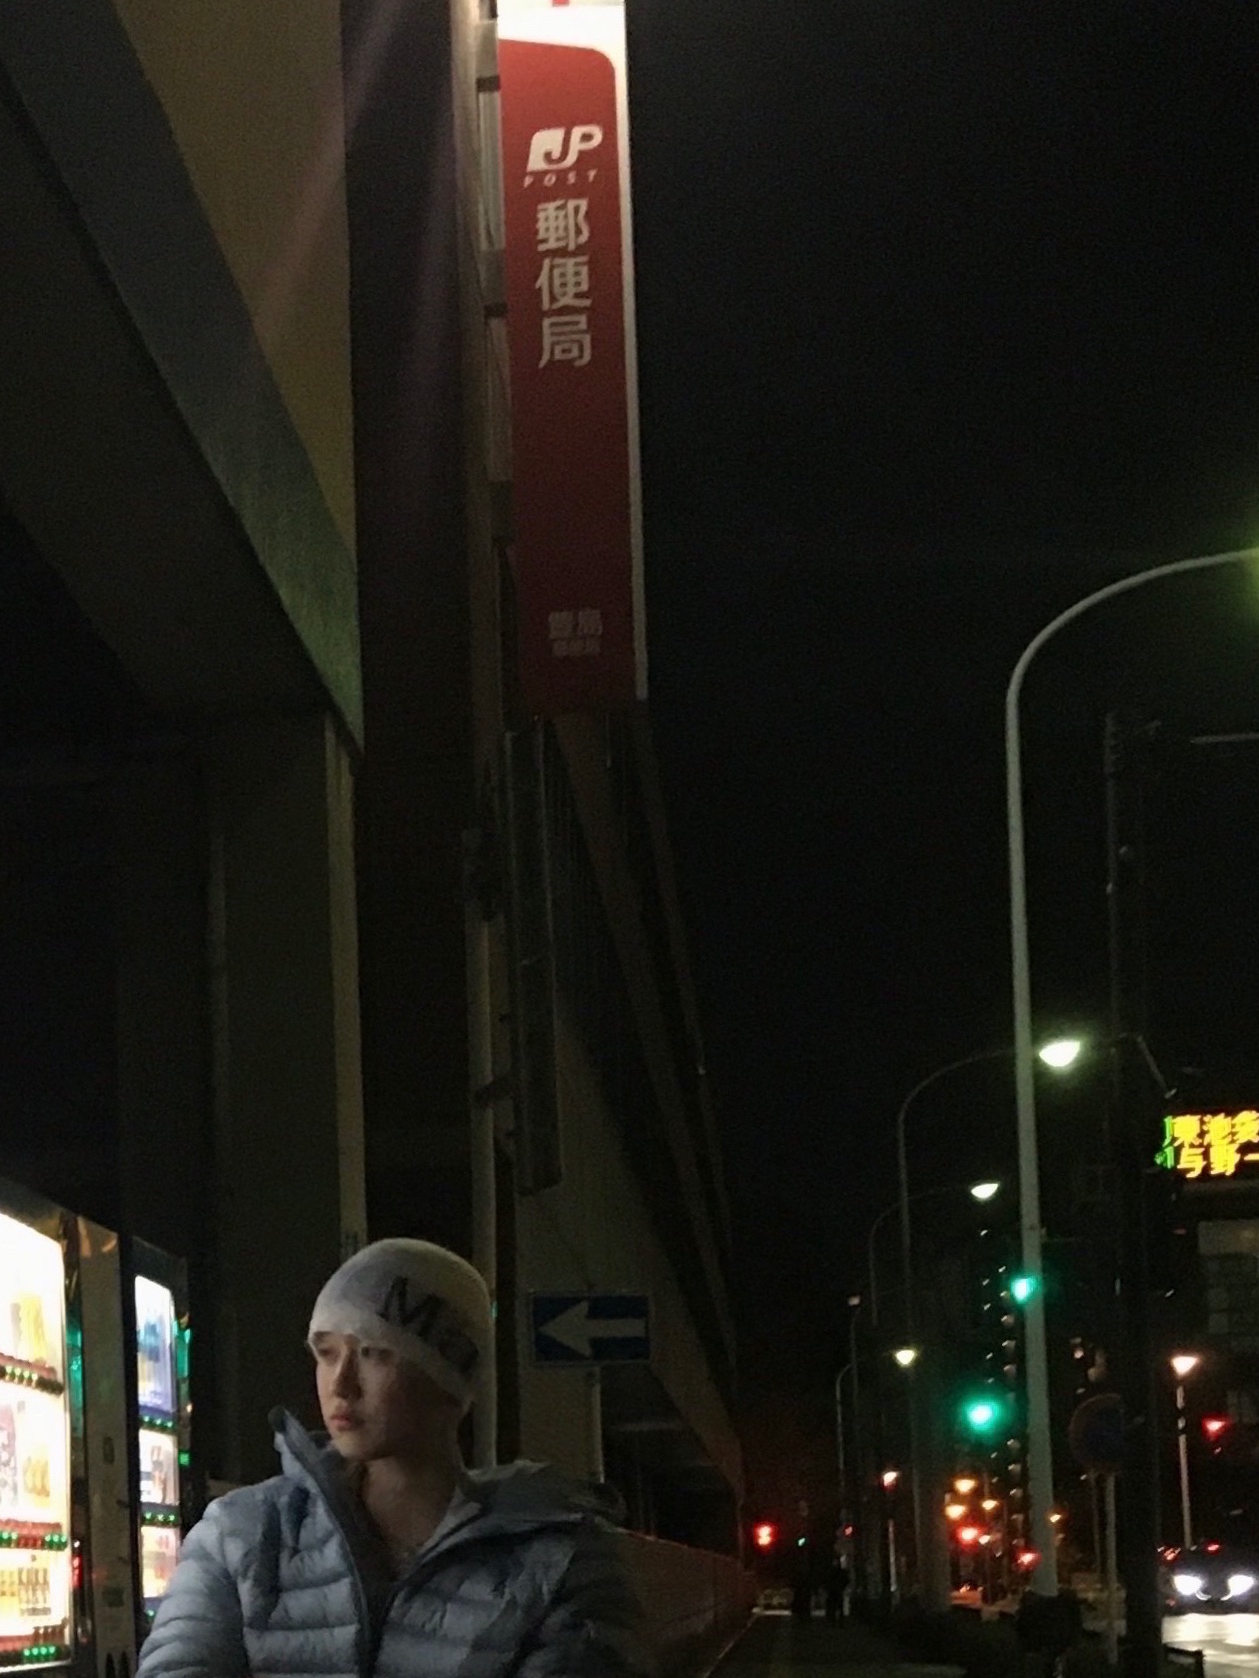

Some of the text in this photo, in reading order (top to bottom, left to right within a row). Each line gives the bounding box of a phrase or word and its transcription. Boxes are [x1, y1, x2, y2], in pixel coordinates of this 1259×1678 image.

[527, 124, 603, 173] JP
[535, 197, 592, 369] 郵便局
